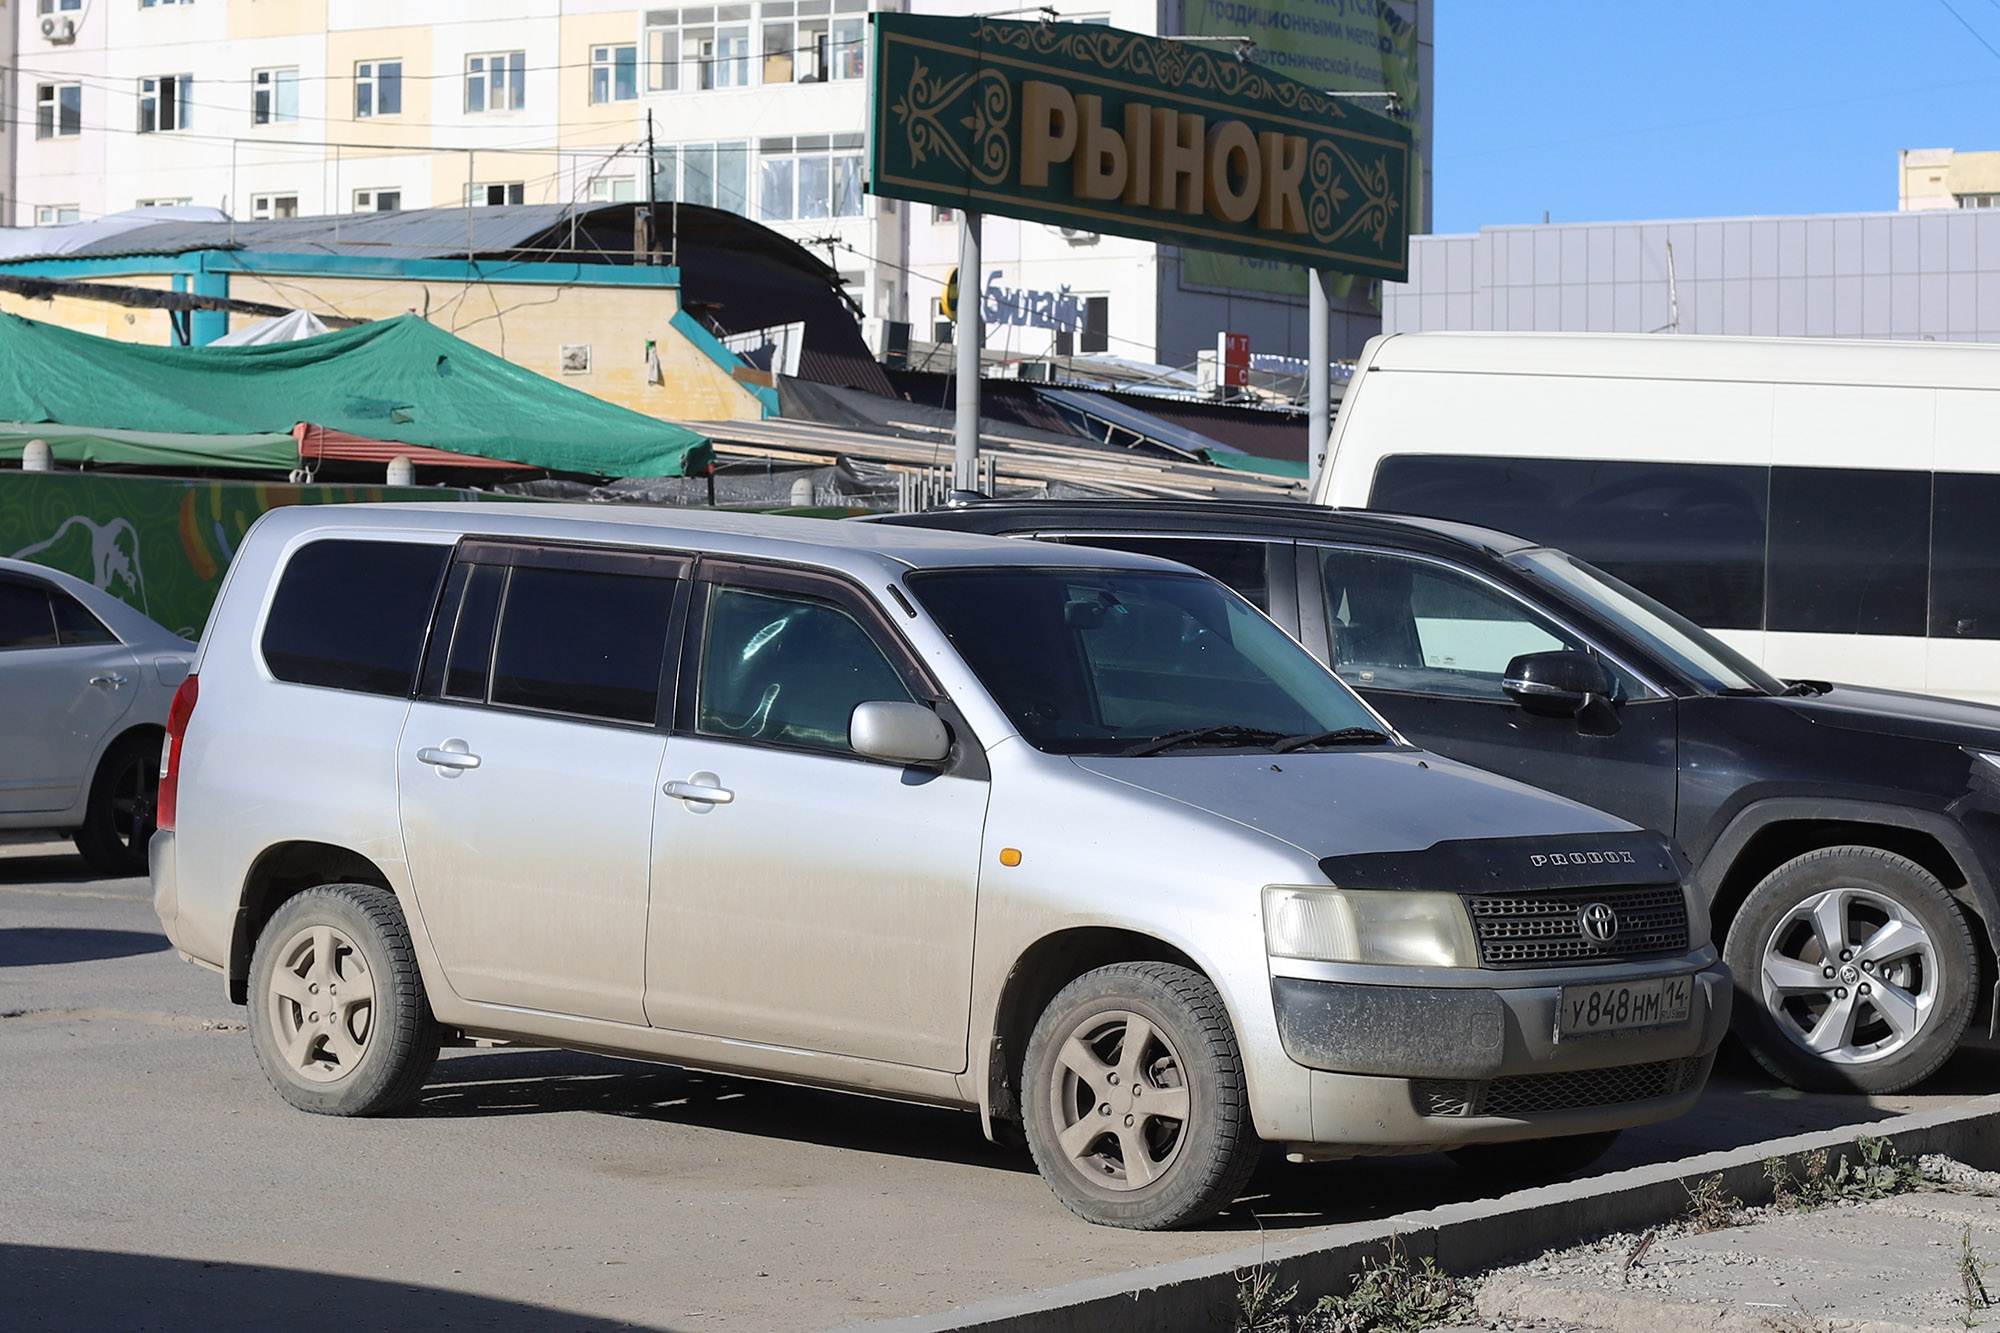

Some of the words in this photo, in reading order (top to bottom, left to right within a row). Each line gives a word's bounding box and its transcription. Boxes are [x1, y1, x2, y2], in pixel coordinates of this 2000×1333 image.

[1208, 1, 1343, 40] традиционными
[1020, 80, 1310, 234] РЫНОК
[1530, 851, 1636, 867] PROBOX
[1661, 1008, 1677, 1020] RUS
